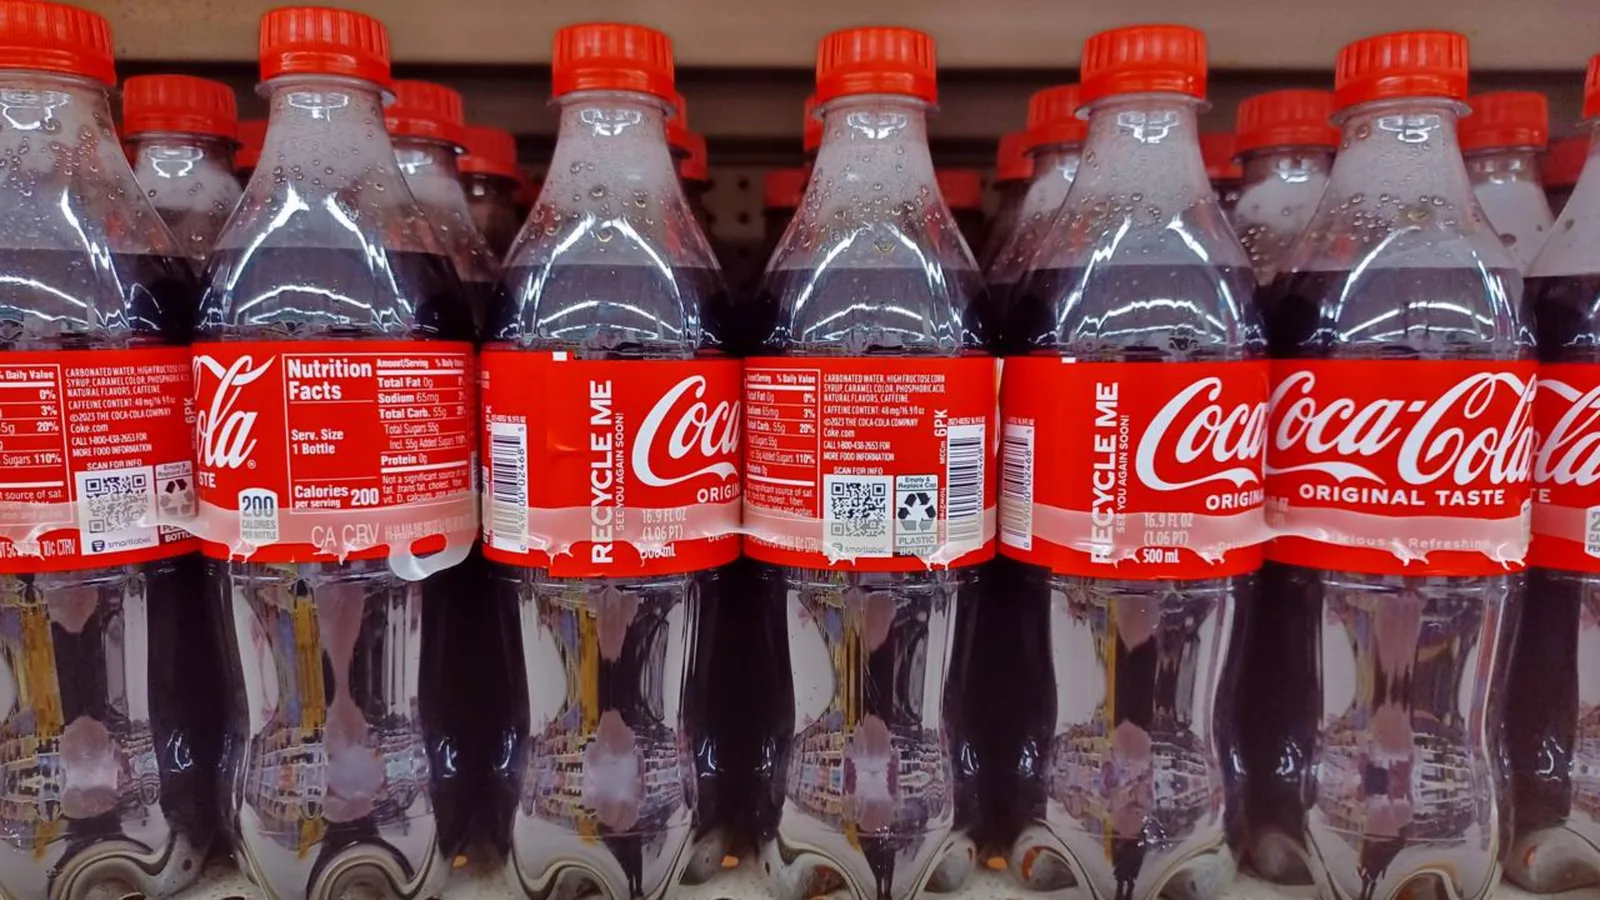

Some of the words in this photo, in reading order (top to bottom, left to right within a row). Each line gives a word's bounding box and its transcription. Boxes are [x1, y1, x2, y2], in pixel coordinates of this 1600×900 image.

[65, 368, 113, 377] CARBONATED
[287, 358, 372, 378] Nutrition
[5, 370, 27, 380] Daily
[29, 370, 54, 379] Value
[377, 377, 404, 388] Total
[406, 377, 421, 387] Fat
[423, 377, 433, 388] 0g
[39, 389, 56, 400] 0%
[289, 381, 342, 400] Facts
[378, 393, 415, 404] Sodium
[416, 392, 440, 405] 65mg
[589, 380, 612, 425] ME
[1095, 382, 1119, 427] ME
[40, 405, 57, 416] 3%
[379, 409, 405, 419] Total
[407, 408, 430, 418] Carb.
[803, 408, 816, 418] 3%
[36, 421, 59, 432] 20%
[70, 423, 108, 434] Coke.com
[384, 424, 403, 434] Total
[933, 409, 947, 437] 6PK
[1267, 370, 1536, 486] Coca-Cola
[291, 429, 319, 441] Serv.
[320, 428, 344, 440] Size
[615, 412, 625, 448] SOON!
[823, 427, 855, 438] Coke.com
[1119, 415, 1129, 449] SOON!
[72, 436, 87, 446] CALL
[292, 444, 299, 455] 1
[302, 442, 336, 455] Bottle
[2, 454, 31, 467] Sugars
[33, 453, 62, 464] 110%
[87, 462, 108, 471] SCAN
[109, 460, 124, 469] FOR
[125, 458, 142, 468] INFO
[381, 454, 417, 466] Protein
[615, 450, 625, 487] AGAIN
[833, 467, 851, 475] SCAN
[852, 467, 867, 475] FOR
[867, 467, 883, 475] INFO
[1118, 453, 1128, 488] AGAIN
[382, 476, 396, 484] Not
[4, 488, 35, 500] source
[294, 485, 349, 499] Calories
[350, 487, 379, 506] 200
[590, 432, 613, 563] RECYCLE
[615, 487, 625, 509] YOU
[1117, 489, 1127, 510] YOU
[1299, 484, 1425, 506] ORIGINAL
[1435, 489, 1505, 506] TASTE
[242, 496, 274, 517] 200
[295, 501, 310, 509] per
[310, 498, 341, 509] serving
[615, 510, 625, 531] SEE
[642, 509, 662, 524] 16.9
[664, 508, 673, 522] FL
[675, 507, 687, 521] OZ
[1144, 513, 1166, 528] 16.9
[1168, 513, 1178, 527] FL
[1180, 513, 1193, 527] OZ
[242, 520, 276, 529] CALORIES
[311, 525, 337, 548] CA
[341, 523, 380, 544] CRV
[668, 523, 683, 540] PT)
[898, 536, 935, 545] PLASTIC
[1143, 549, 1163, 563] 500
